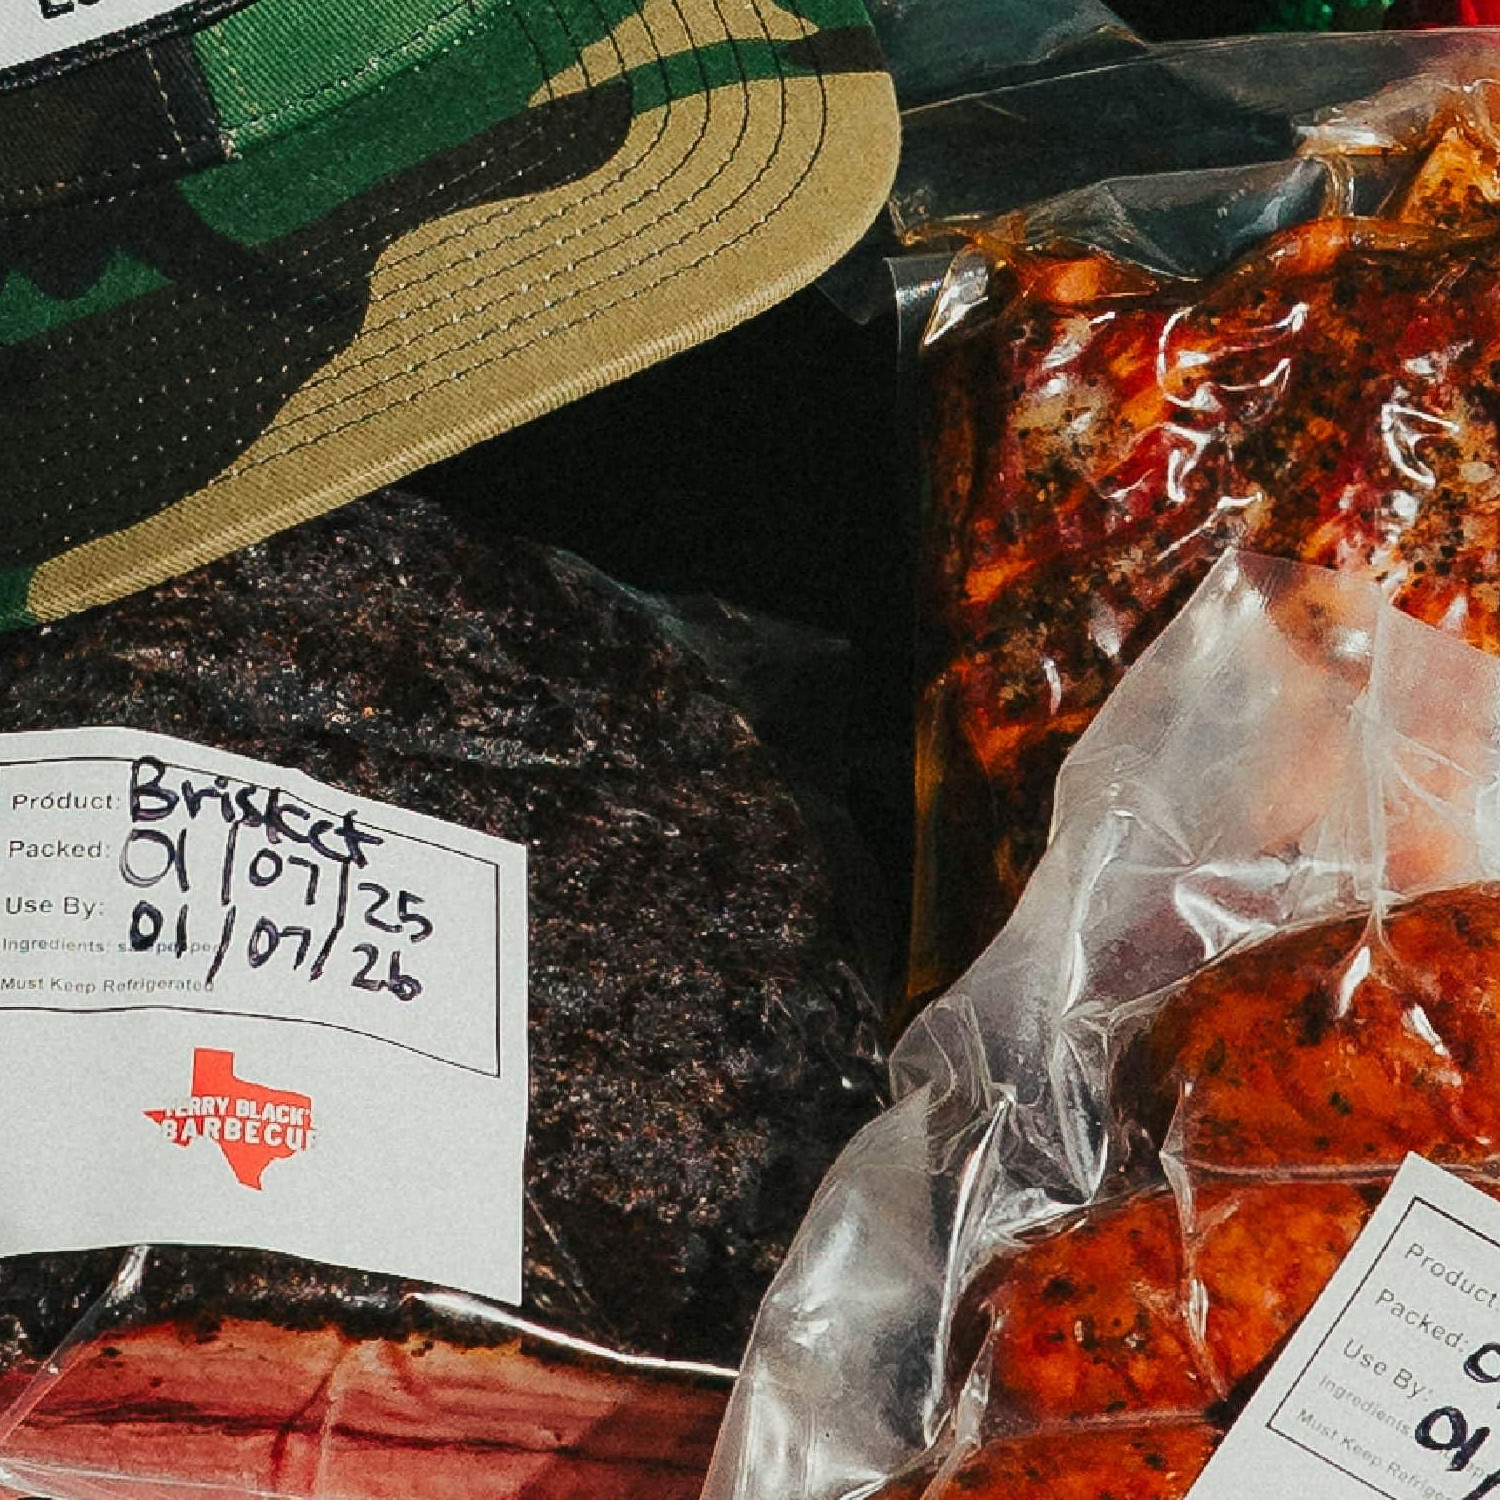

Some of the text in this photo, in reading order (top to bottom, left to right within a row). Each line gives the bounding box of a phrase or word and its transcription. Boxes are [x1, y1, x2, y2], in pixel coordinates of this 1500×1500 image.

[8, 840, 111, 860] Packed:
[4, 896, 105, 920] Use By:
[0, 977, 44, 991] Must
[49, 978, 96, 995] Keep
[1375, 1288, 1469, 1353] Packed:
[1343, 1338, 1434, 1403] Use By:
[1296, 1408, 1338, 1440] Must
